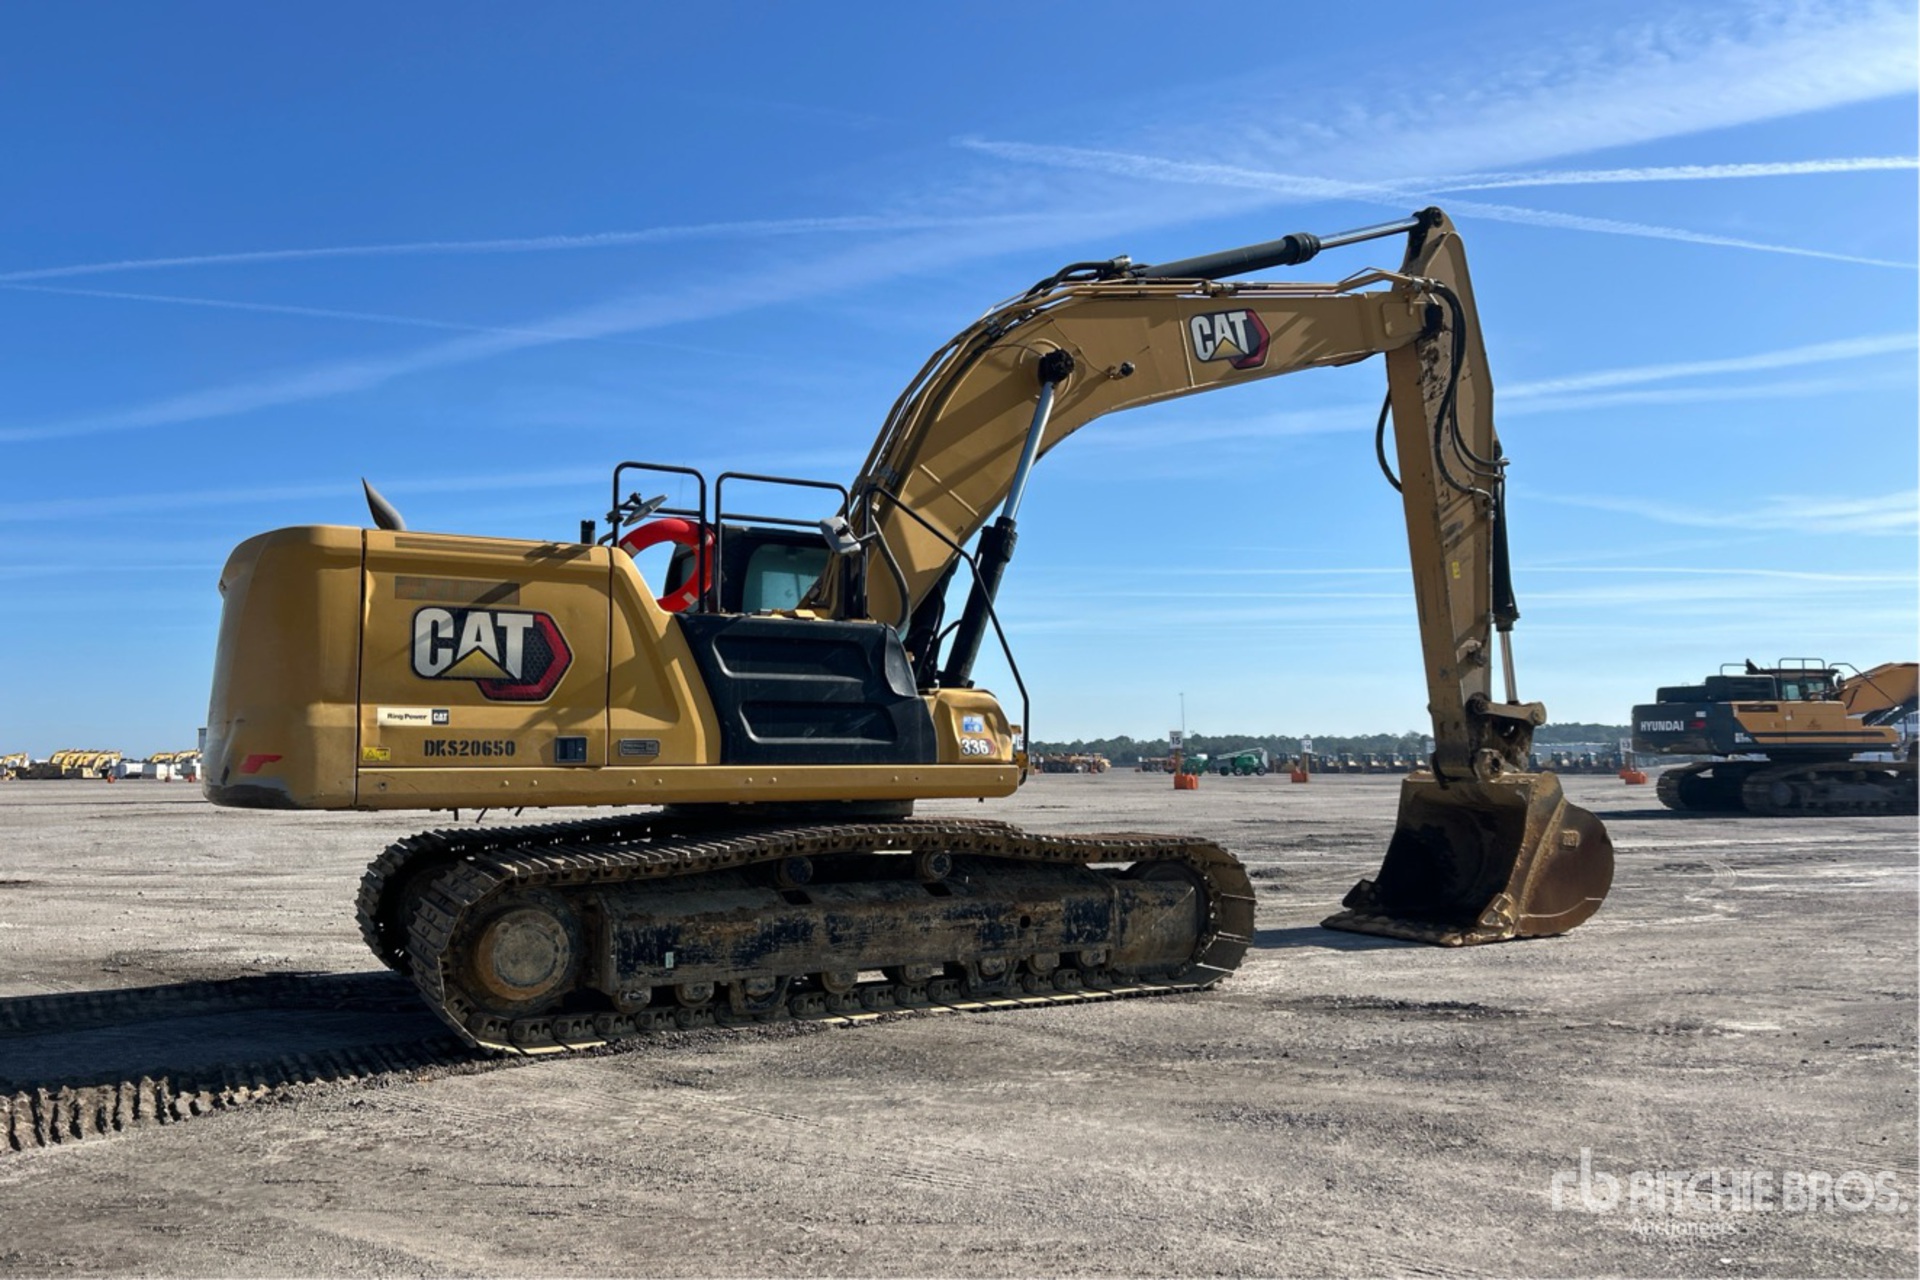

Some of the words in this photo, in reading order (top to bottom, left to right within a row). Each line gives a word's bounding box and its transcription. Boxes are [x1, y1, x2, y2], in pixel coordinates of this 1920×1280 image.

[1191, 310, 1249, 361] CAT
[414, 607, 534, 680] CAT
[433, 713, 447, 721] CAT
[1640, 720, 1684, 732] HYUNDAI
[424, 739, 516, 757] DKS20650
[961, 738, 989, 755] 336
